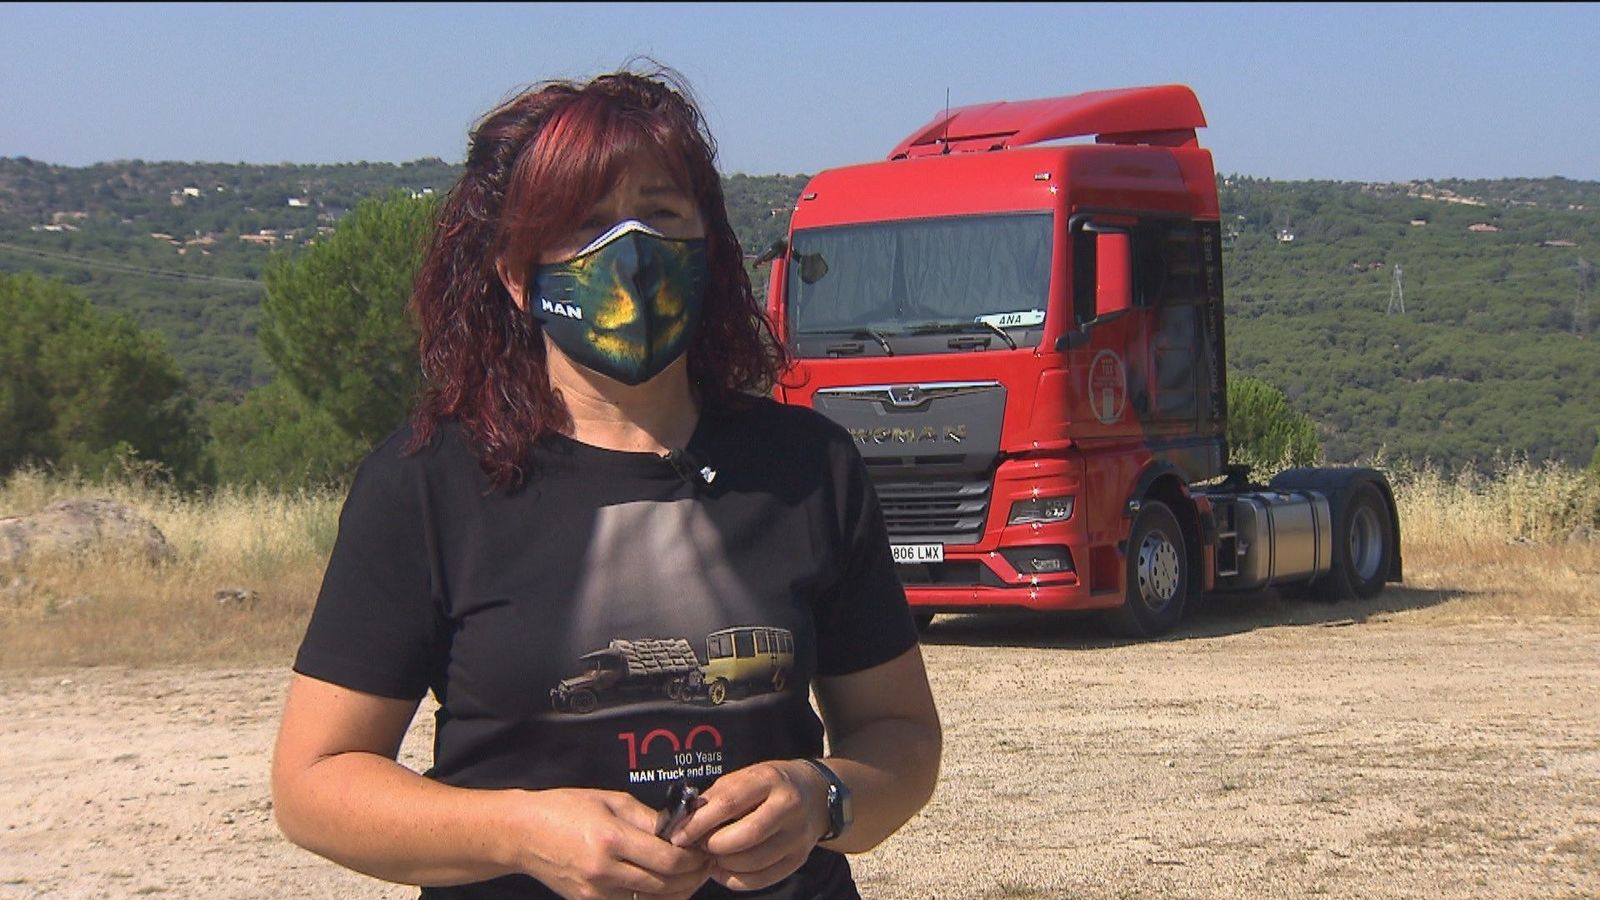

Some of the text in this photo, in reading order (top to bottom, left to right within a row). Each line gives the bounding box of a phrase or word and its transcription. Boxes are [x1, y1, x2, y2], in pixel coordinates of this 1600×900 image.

[541, 297, 582, 320] MAN
[999, 314, 1021, 325] ANA
[917, 546, 940, 560] LMX
[674, 751, 722, 766] 100 Years
[629, 764, 722, 783] MAN Truck and Bus
